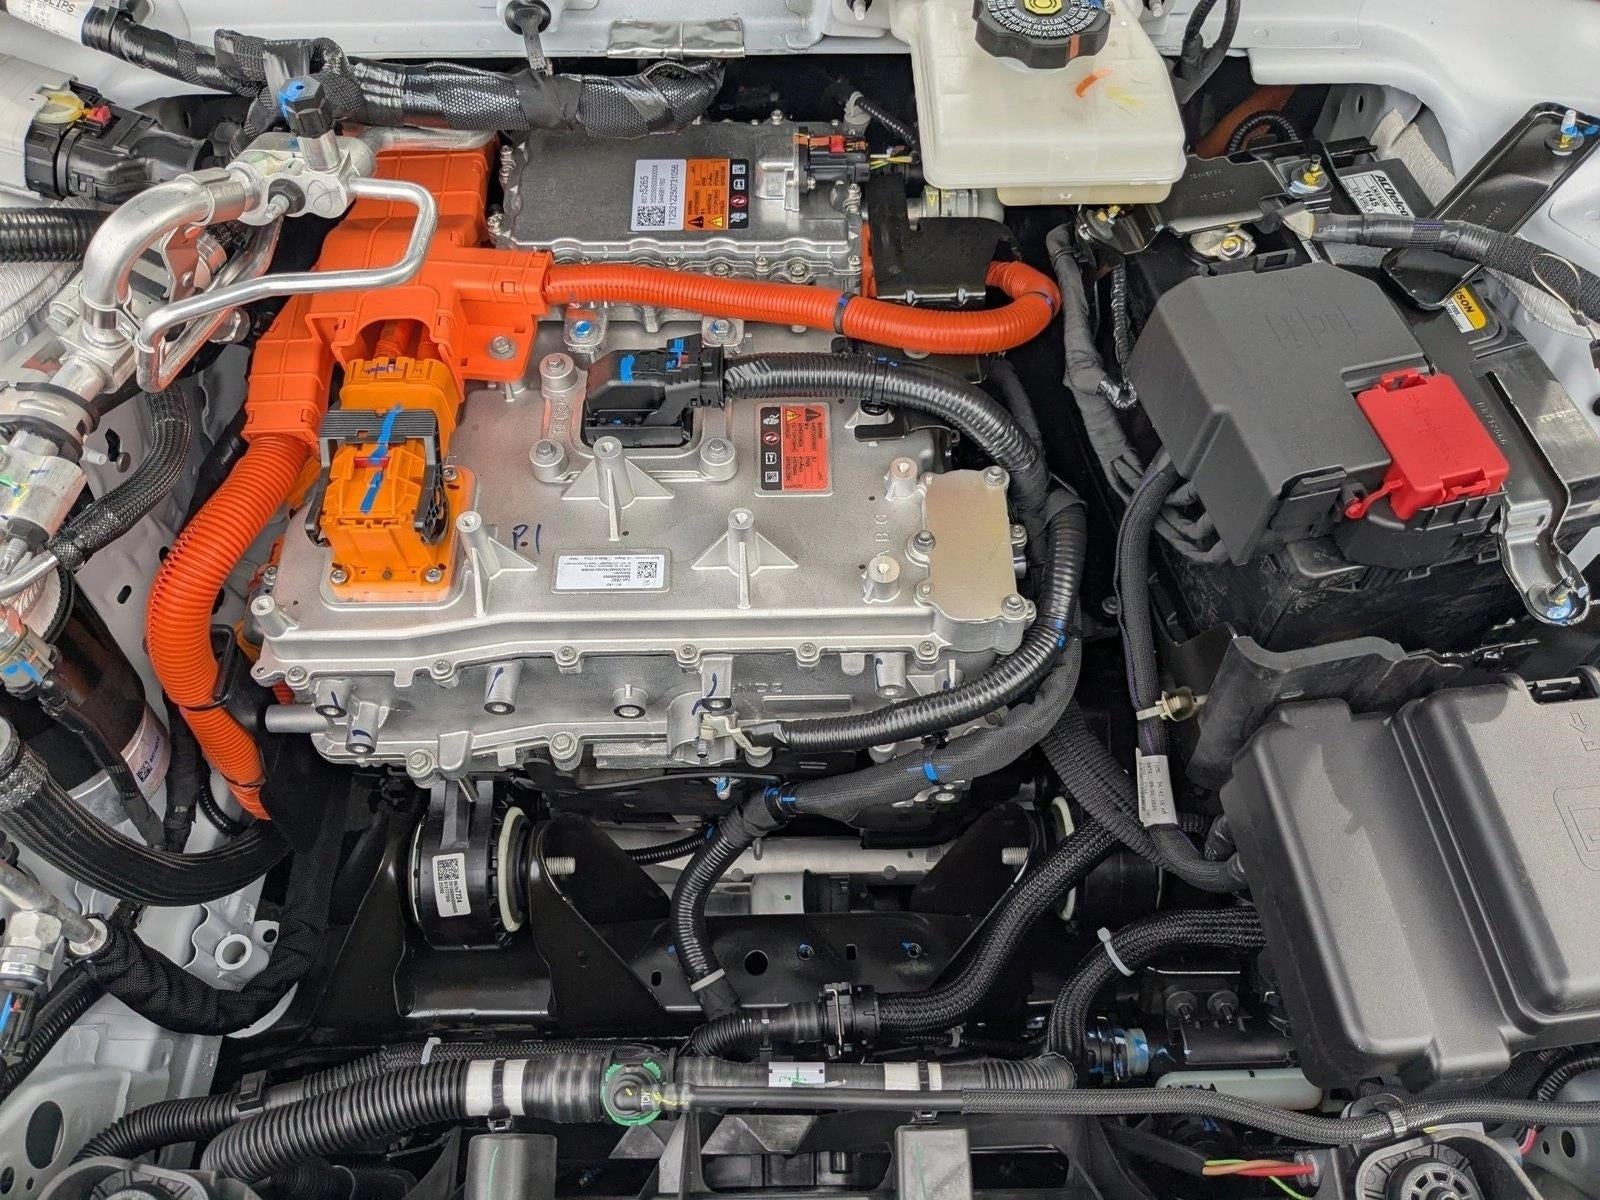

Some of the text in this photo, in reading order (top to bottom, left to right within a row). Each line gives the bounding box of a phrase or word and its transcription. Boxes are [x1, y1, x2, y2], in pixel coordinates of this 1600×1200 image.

[1041, 17, 1063, 25] CLEAN
[1021, 27, 1042, 36] FROM
[1048, 27, 1073, 36] SEALED
[1363, 189, 1380, 207] 1145
[1374, 174, 1410, 217] ACDelco
[1456, 290, 1475, 313] ISON
